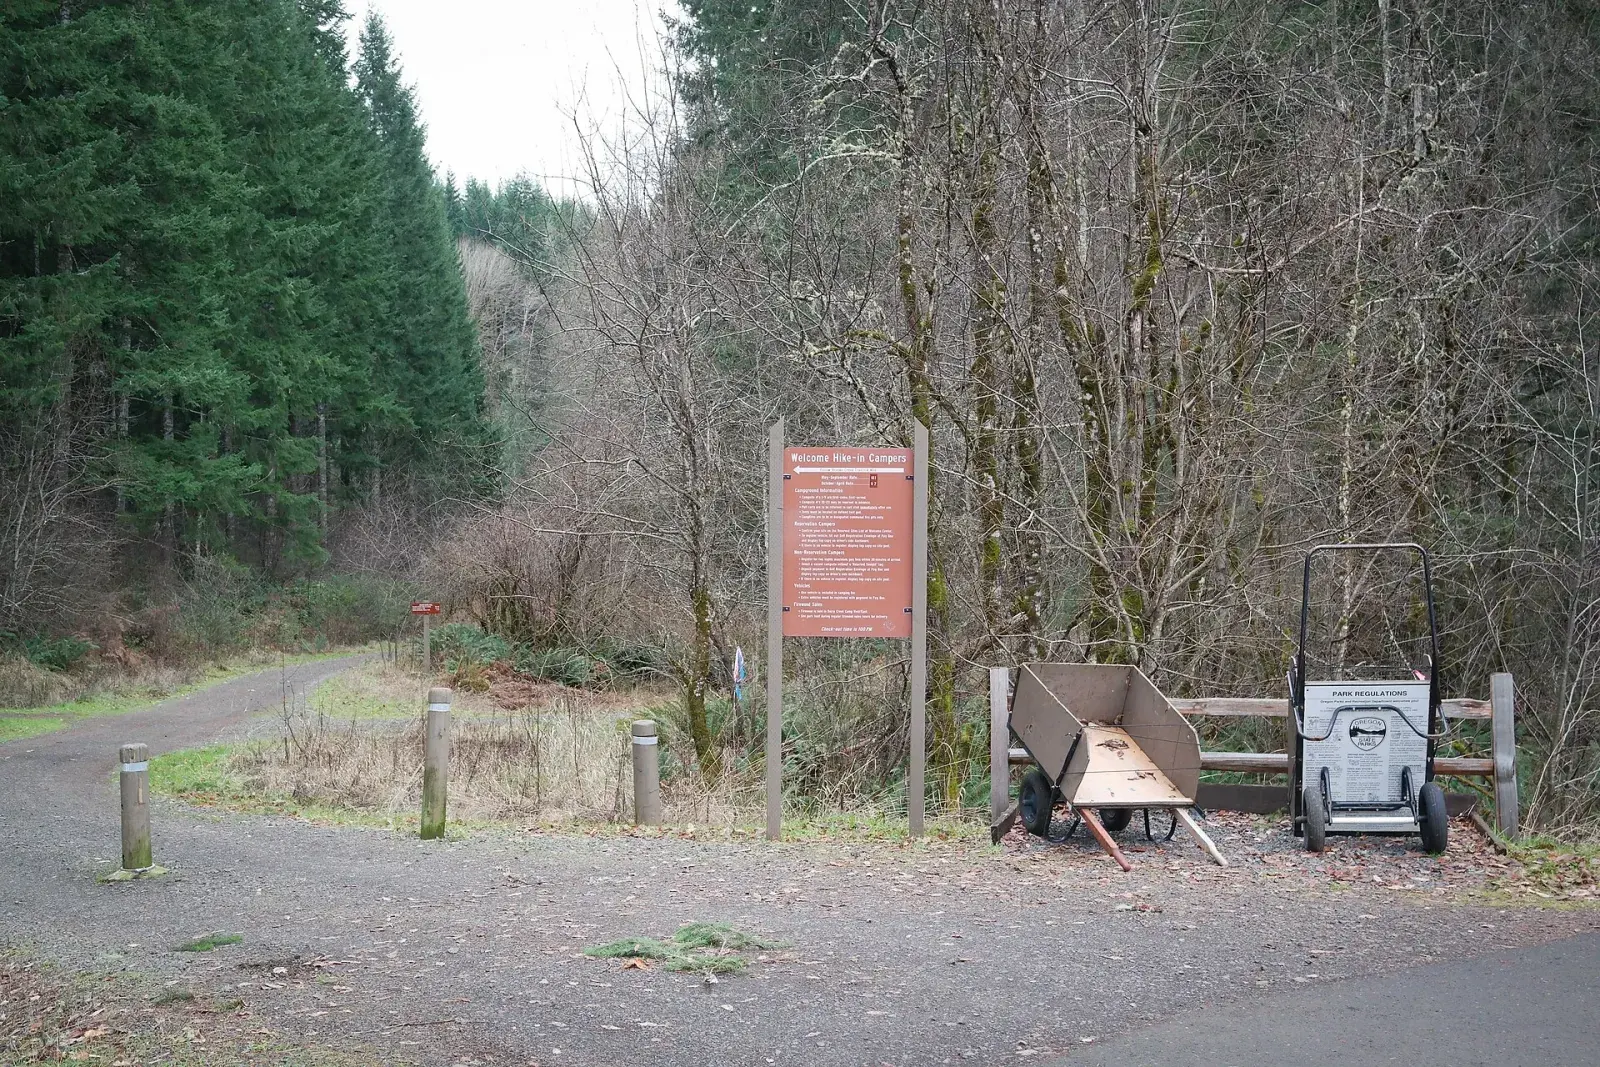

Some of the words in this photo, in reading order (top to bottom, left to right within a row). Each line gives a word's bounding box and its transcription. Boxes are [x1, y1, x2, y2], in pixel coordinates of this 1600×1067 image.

[791, 453, 829, 462] Welcome
[833, 453, 864, 462] Hike-in
[869, 453, 906, 464] Campers
